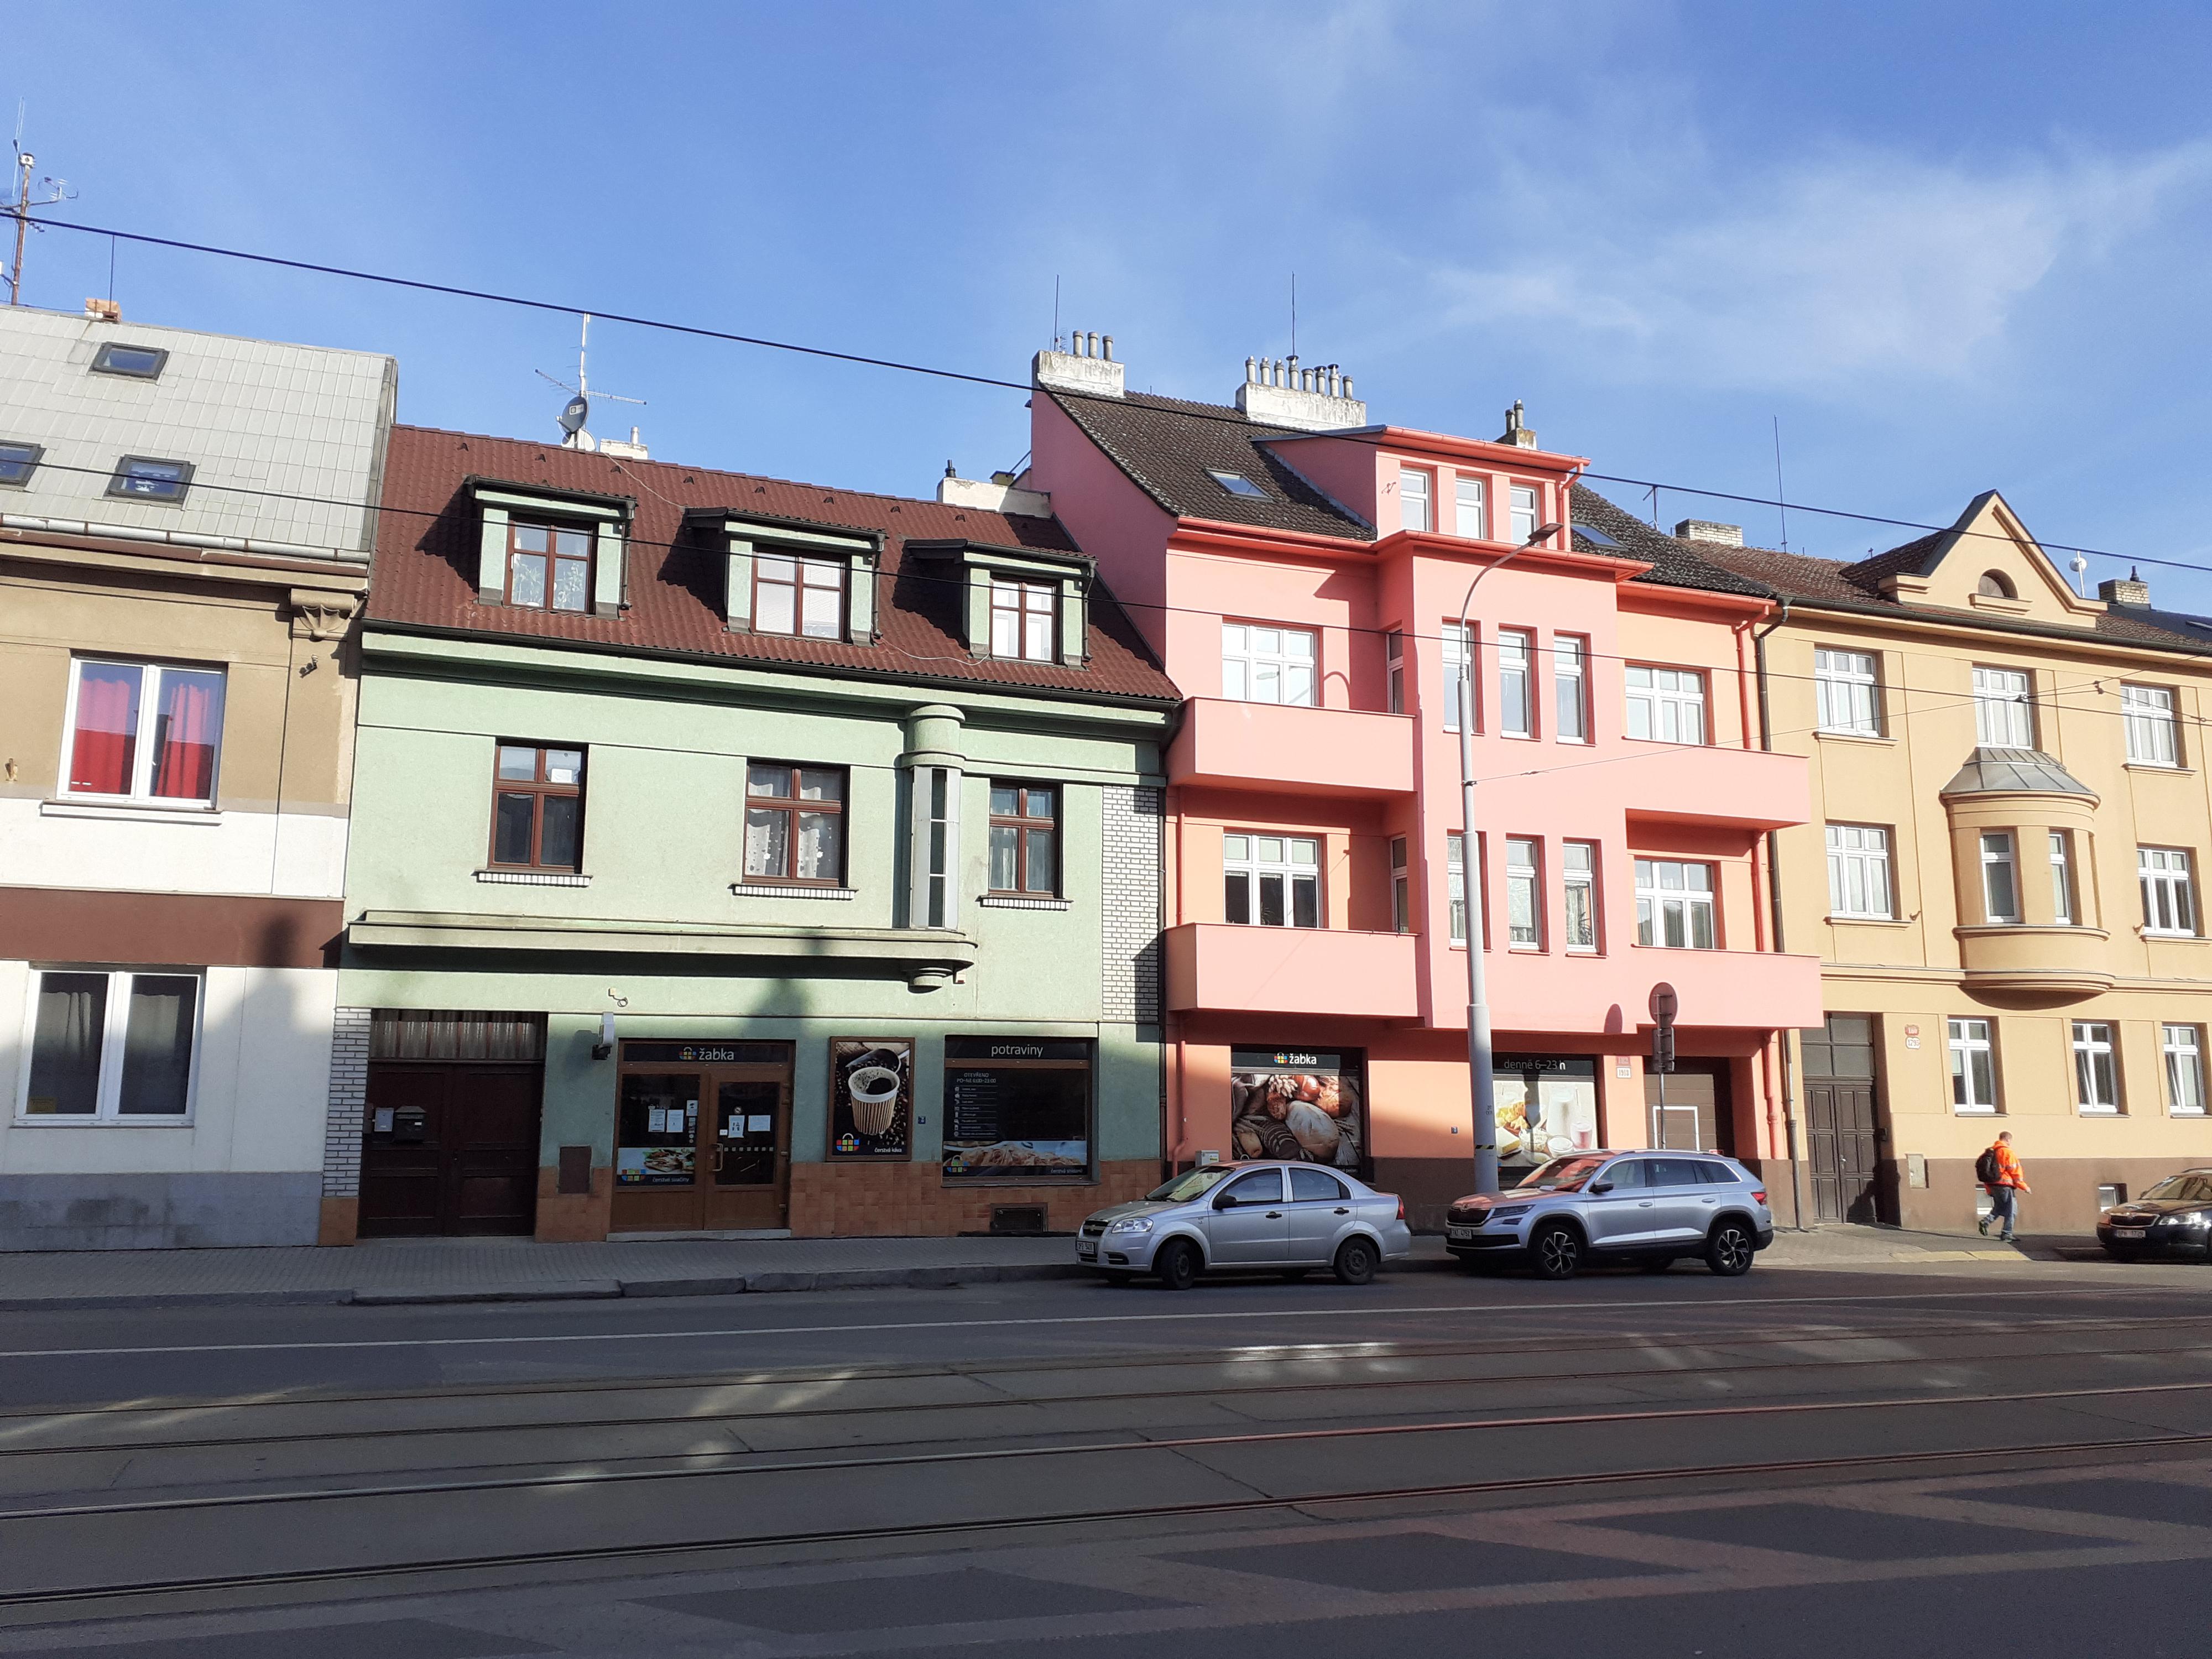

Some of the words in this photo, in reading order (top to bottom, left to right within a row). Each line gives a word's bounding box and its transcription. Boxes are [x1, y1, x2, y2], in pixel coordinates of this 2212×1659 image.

[698, 1047, 734, 1060] žabka
[991, 1044, 1044, 1058] potraviny
[1289, 1053, 1317, 1065] žabka
[1504, 1058, 1533, 1070] denně
[1559, 1060, 1566, 1070] h
